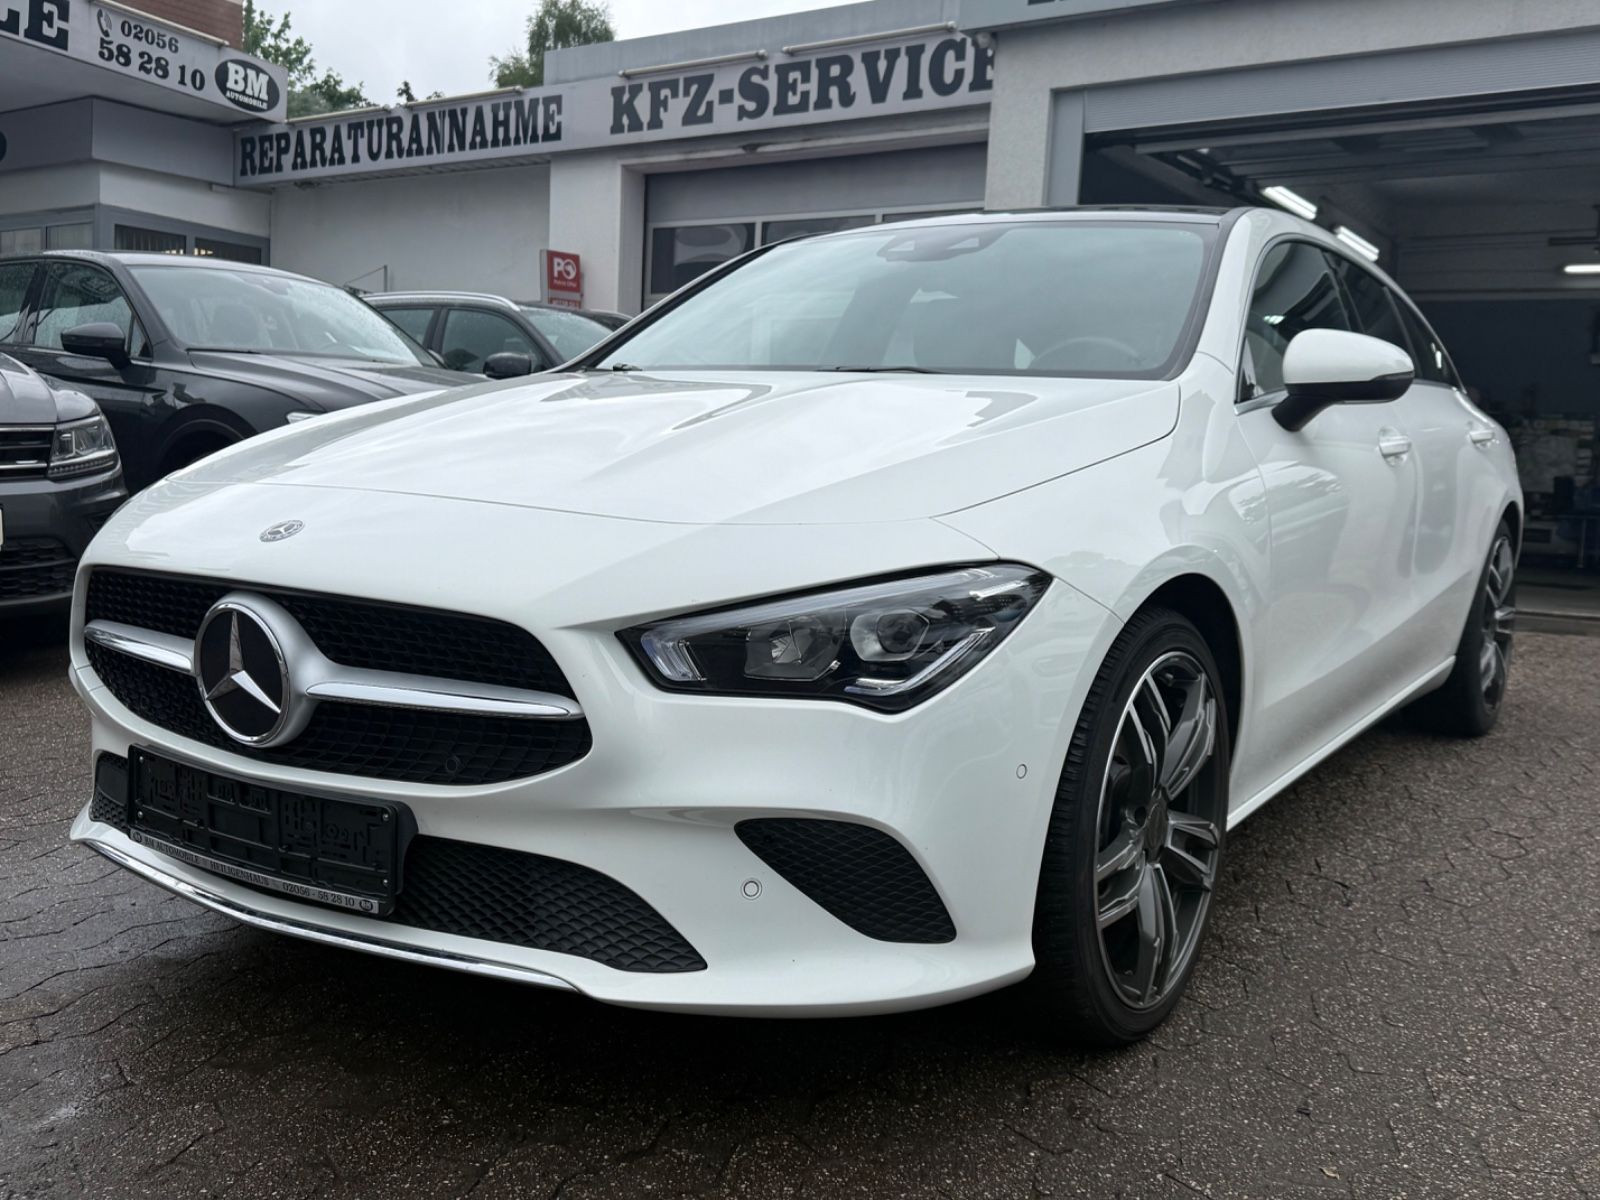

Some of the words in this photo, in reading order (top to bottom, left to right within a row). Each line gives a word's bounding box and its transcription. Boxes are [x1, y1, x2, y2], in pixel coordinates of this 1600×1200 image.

[120, 20, 179, 53] 02056
[98, 37, 132, 67] 58
[138, 51, 169, 80] 28
[178, 65, 206, 91] 10
[226, 61, 269, 101] BM
[225, 90, 268, 110] AUTOMOBILE
[240, 94, 563, 177] REPARATURANNAHME
[210, 860, 270, 886] HEILIGENHAUS
[282, 882, 310, 897] 02056
[318, 891, 329, 902] 58
[331, 893, 343, 905] 28
[345, 896, 355, 907] 10
